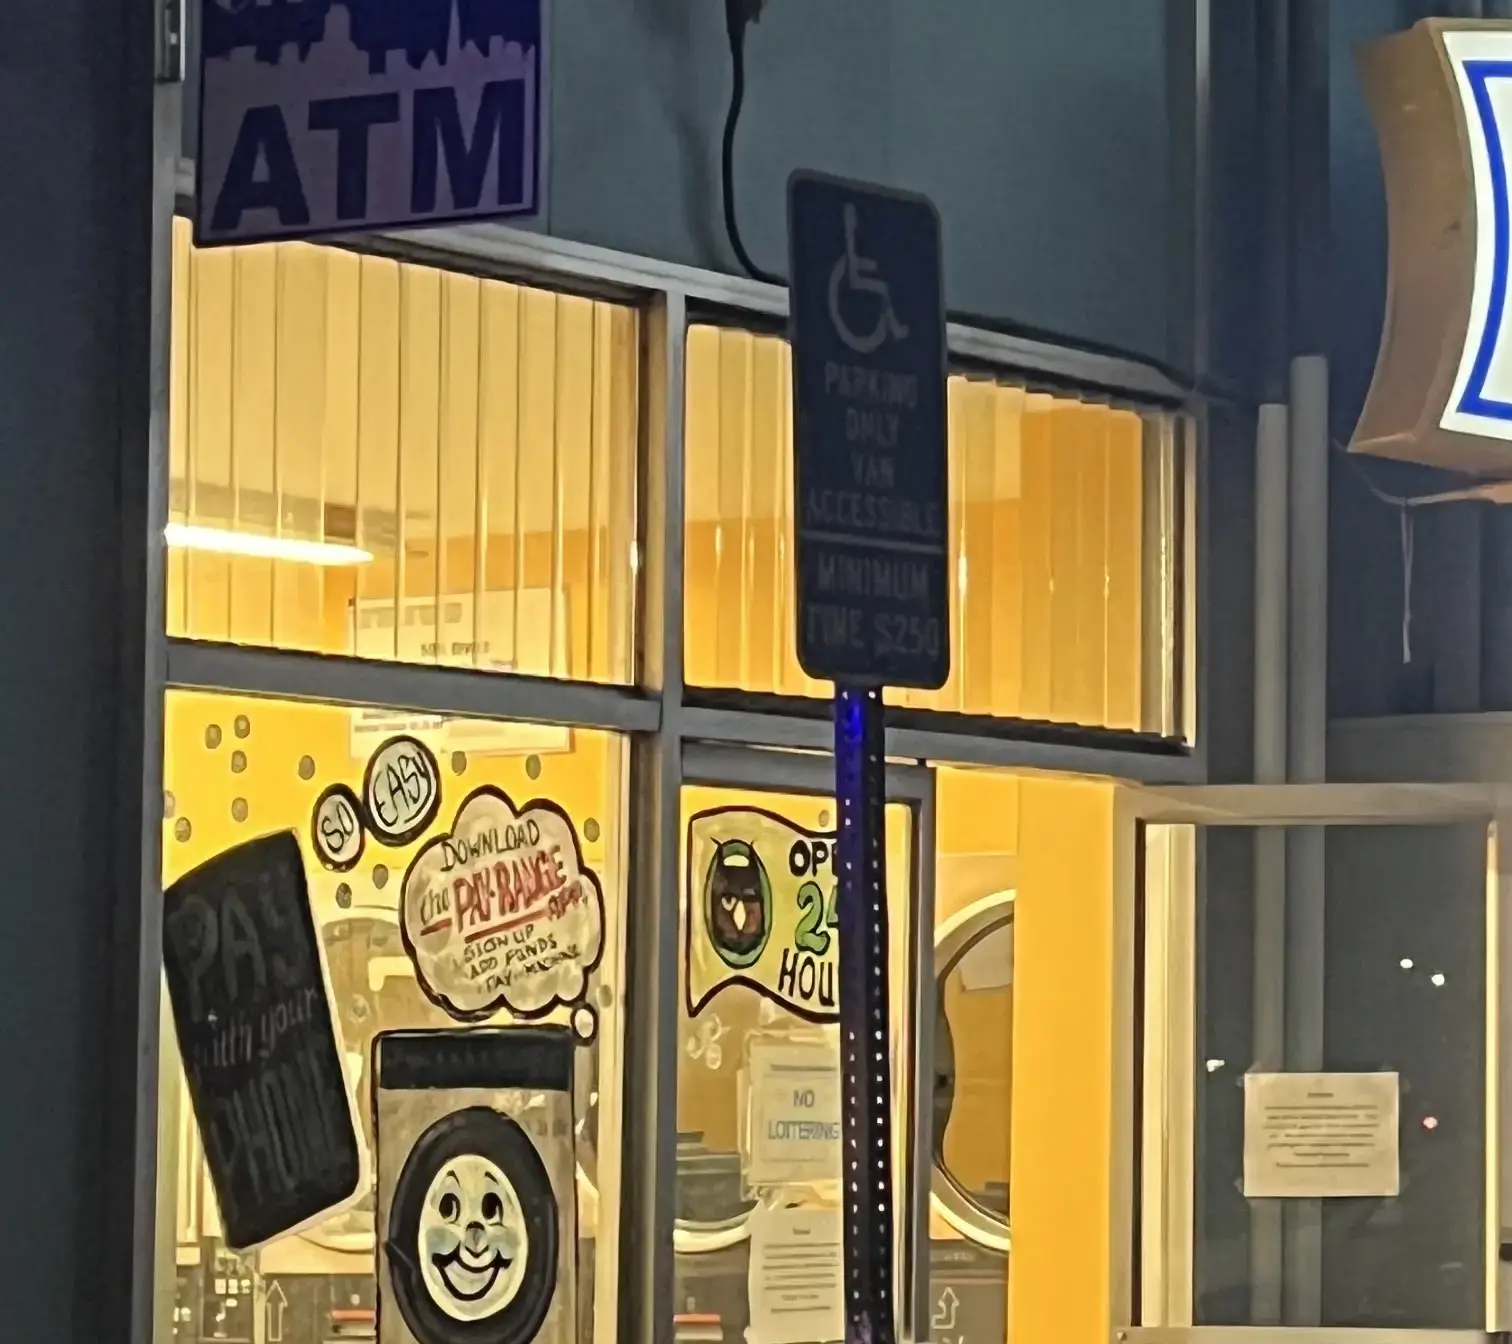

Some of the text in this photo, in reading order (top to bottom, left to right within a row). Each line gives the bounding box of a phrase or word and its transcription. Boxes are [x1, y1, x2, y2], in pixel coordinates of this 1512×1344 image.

[210, 78, 525, 232] ATM
[824, 360, 918, 409] PARKING
[845, 407, 899, 447] ONLY
[848, 447, 895, 488] VAN
[806, 488, 941, 536] ACCESSIBLE
[817, 552, 929, 601] MINIMUM
[806, 602, 940, 662] FINE $250
[321, 751, 432, 854] SO EASY
[440, 819, 540, 872] DOWNLOAD
[789, 839, 839, 877] OP
[469, 933, 558, 979] ADD FUNDS
[513, 923, 535, 947] UP
[777, 947, 836, 1007] HOU
[260, 986, 319, 1056] your
[792, 1089, 815, 1108] NO
[768, 1120, 841, 1141] LOITERING
